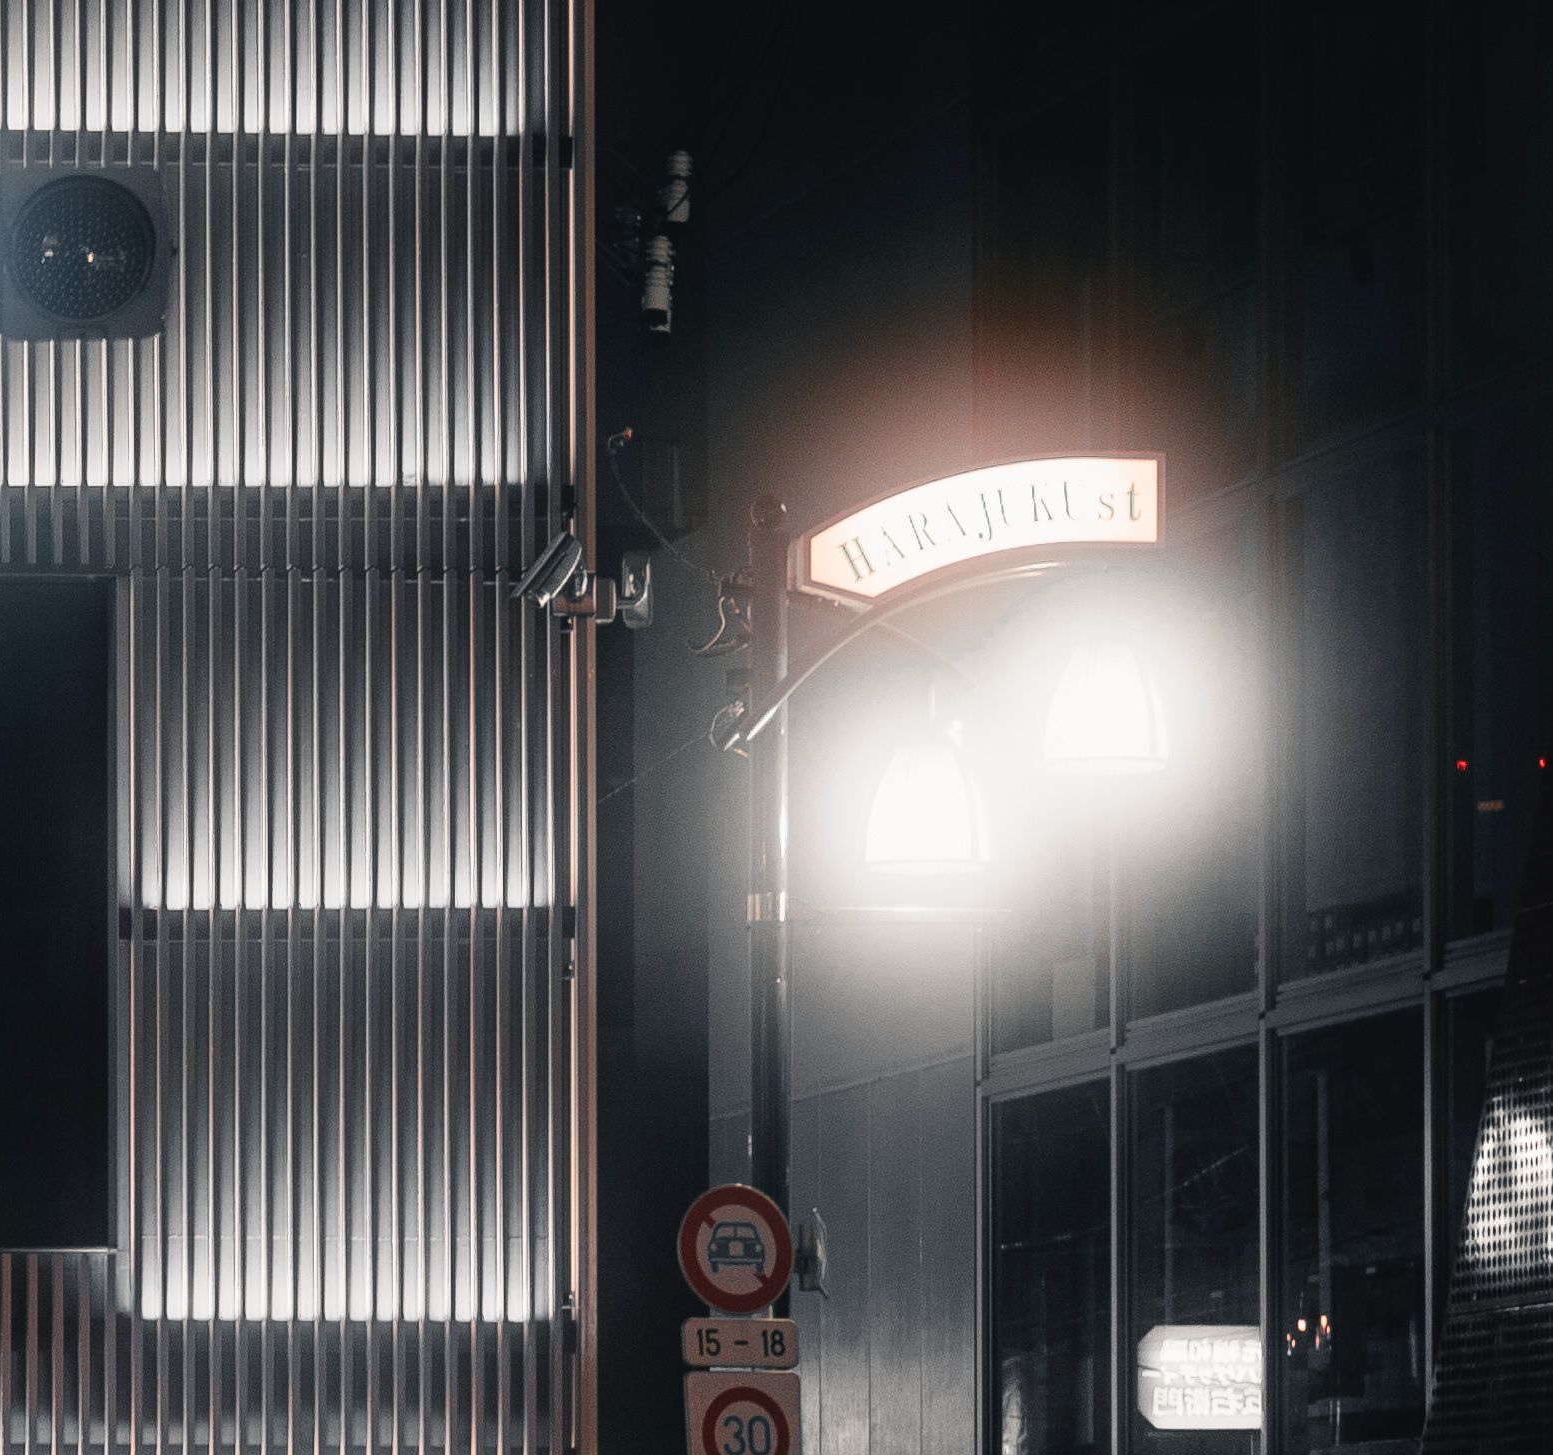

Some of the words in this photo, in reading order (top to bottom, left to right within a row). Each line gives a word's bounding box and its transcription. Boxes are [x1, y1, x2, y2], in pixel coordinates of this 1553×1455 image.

[837, 480, 1087, 583] HARAJUKU
[1098, 481, 1142, 522] st
[696, 1328, 722, 1358] 15
[761, 1326, 787, 1357] 18
